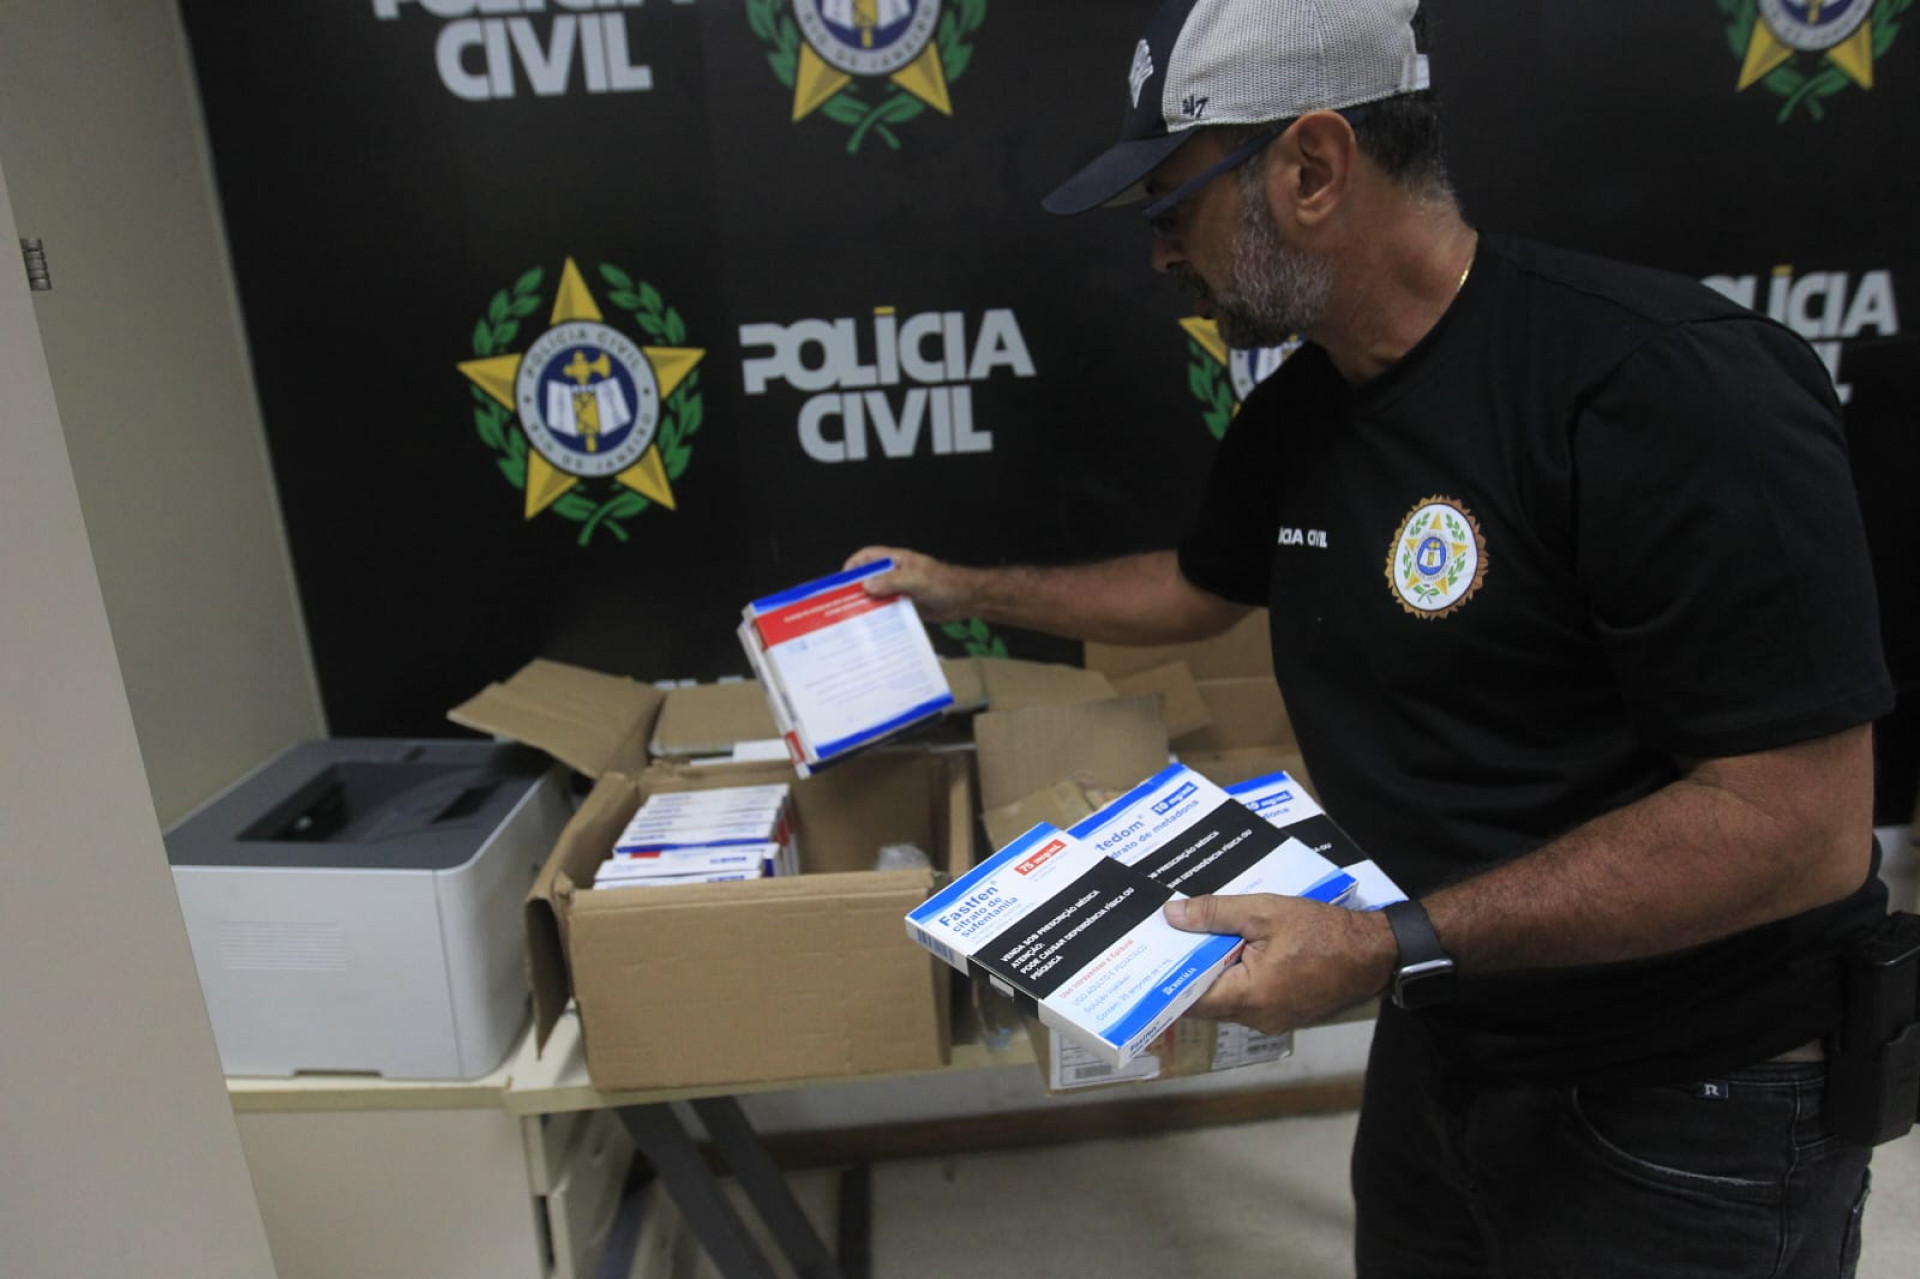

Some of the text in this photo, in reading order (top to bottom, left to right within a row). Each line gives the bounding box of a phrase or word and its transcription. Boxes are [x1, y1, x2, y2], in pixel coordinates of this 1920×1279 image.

[435, 12, 653, 101] CIVIL
[739, 307, 1036, 394] POLÍCIA
[797, 385, 992, 463] CIVIL
[1138, 830, 1153, 843] de
[1152, 799, 1200, 833] metadona
[938, 885, 999, 927] Fastfen
[953, 906, 988, 933] citrato
[961, 896, 1019, 938] sufentanila
[1000, 944, 1027, 962] VENDA
[1022, 933, 1039, 946] SOB
[1036, 906, 1077, 936] PRESCRIÇÃO
[1075, 889, 1101, 908] MÉDICA
[1020, 886, 1135, 974] PODE CAUSAR DEPENDÊNCIA FÍSICA OU
[1030, 954, 1064, 980] PSÍQUICA
